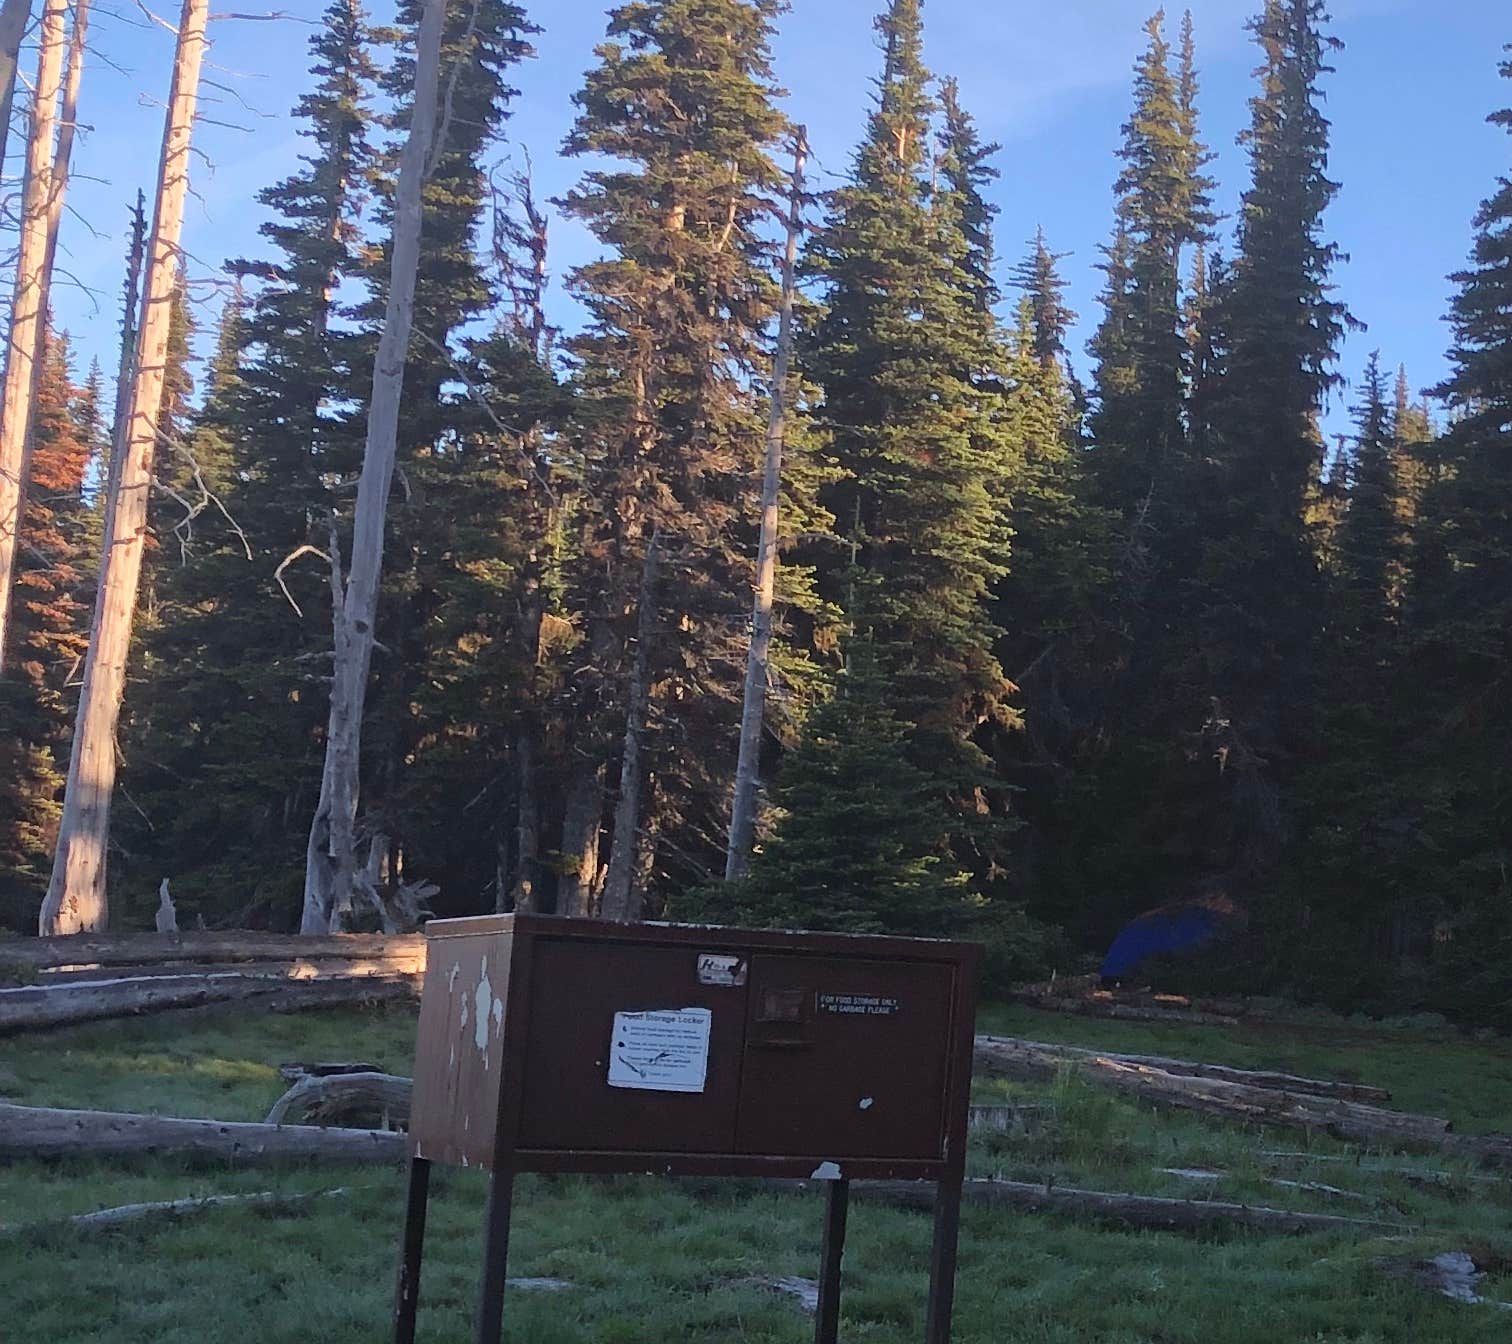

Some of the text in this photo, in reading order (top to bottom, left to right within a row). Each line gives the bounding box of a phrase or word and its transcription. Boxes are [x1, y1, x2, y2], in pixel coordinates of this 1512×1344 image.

[836, 996, 852, 1004] FOOD
[646, 1014, 676, 1024] Storage
[678, 1016, 705, 1024] Locker
